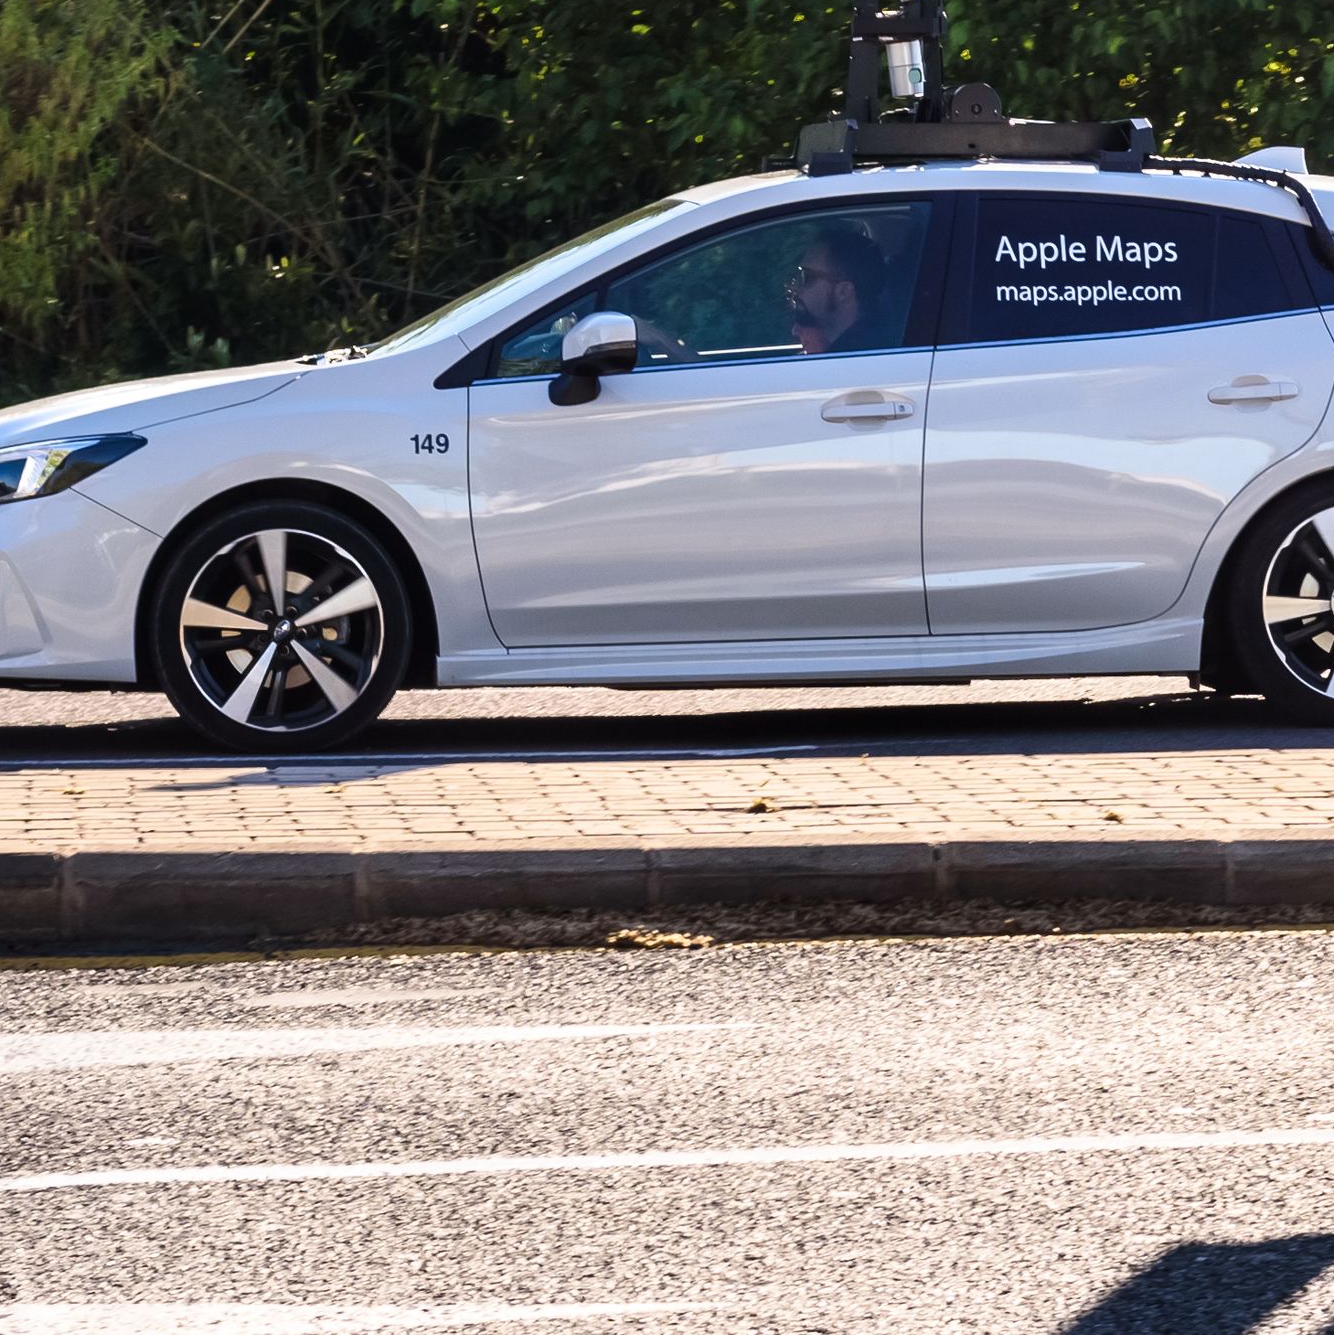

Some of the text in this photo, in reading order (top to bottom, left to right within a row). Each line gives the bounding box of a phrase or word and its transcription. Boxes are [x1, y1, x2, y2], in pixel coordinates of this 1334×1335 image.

[995, 234, 1178, 270] Apple Maps
[996, 279, 1182, 306] maps.apple.com
[410, 433, 450, 455] 149
